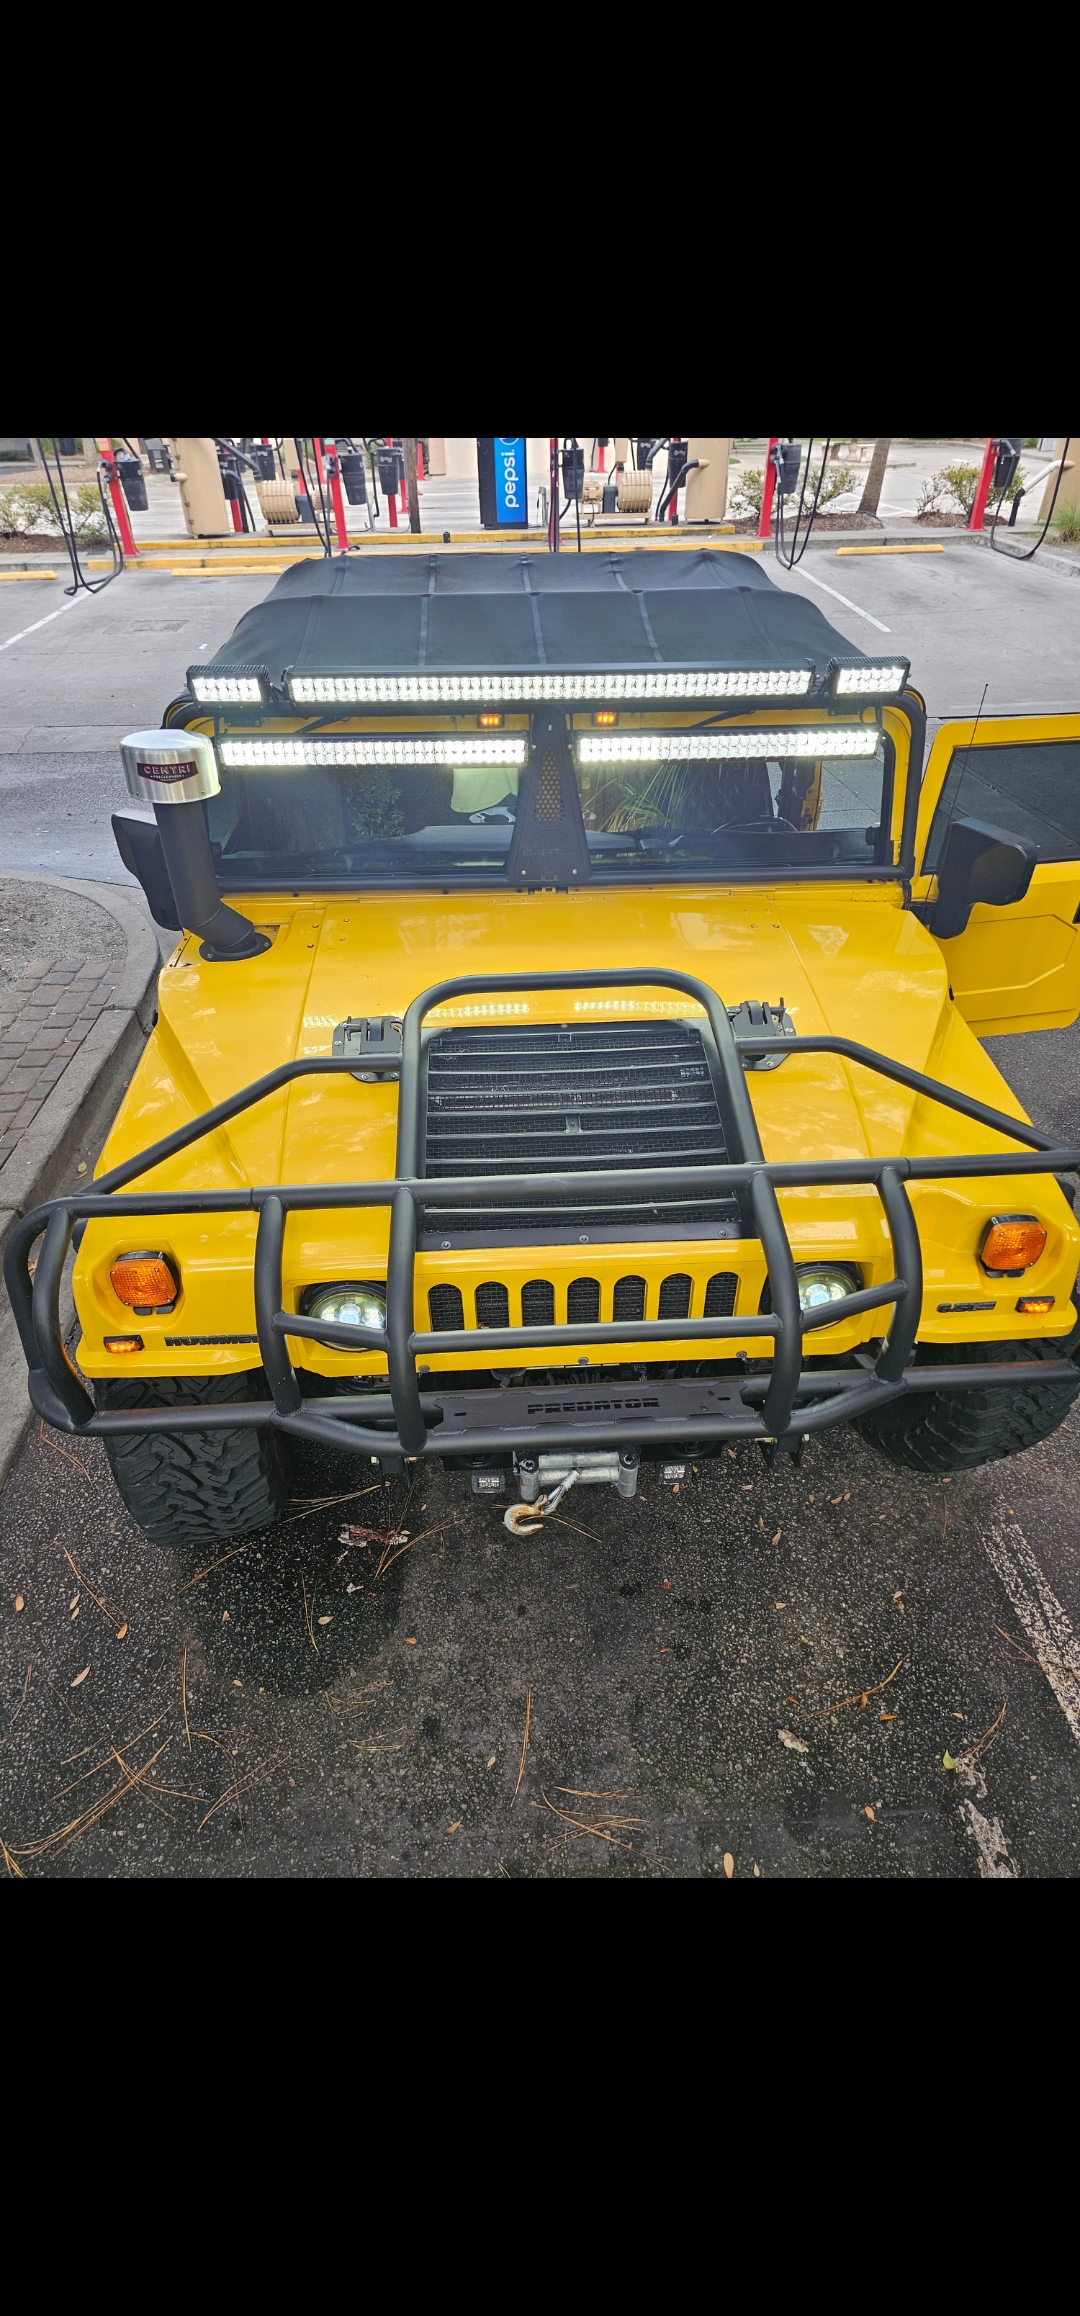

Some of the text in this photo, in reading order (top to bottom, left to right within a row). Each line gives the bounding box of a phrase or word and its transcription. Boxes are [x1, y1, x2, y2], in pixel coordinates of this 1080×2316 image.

[501, 451, 519, 508] pepsi
[143, 764, 190, 775] CENTRI
[527, 1397, 661, 1415] PREDATOR
